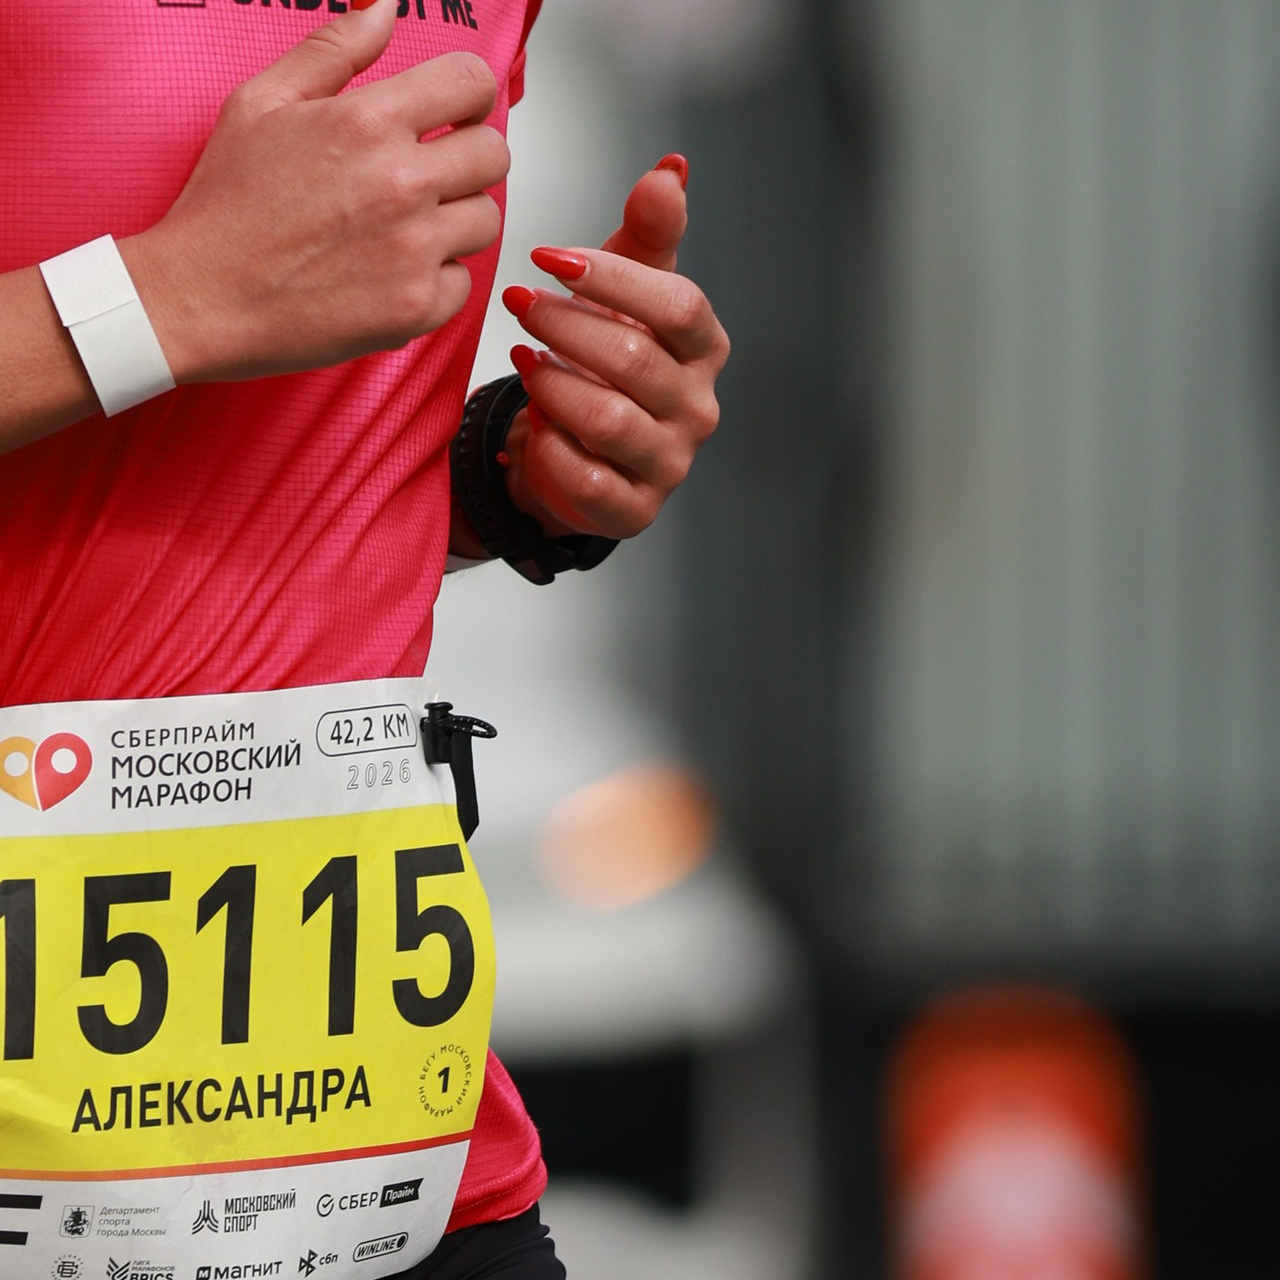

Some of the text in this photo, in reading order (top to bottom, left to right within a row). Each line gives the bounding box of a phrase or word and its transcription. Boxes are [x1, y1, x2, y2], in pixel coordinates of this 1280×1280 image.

[111, 720, 255, 748] СБЕРПРАЙМ
[330, 712, 410, 747] 42,2 КМ
[111, 739, 302, 779] МОСКОВСКИЙ
[346, 758, 411, 790] 2026
[111, 777, 253, 809] МАРАФОН
[437, 1066, 450, 1094] 1
[71, 1065, 372, 1132] АЛЕКСАНДРА
[100, 1206, 160, 1215] Департамент
[224, 1188, 297, 1215] МОСКОВСКИЙ
[339, 1186, 415, 1210] СБЕР Прайм
[97, 1228, 167, 1237] города Москвы
[98, 1219, 131, 1227] спорта
[224, 1214, 259, 1233] СПОРТ
[357, 1238, 397, 1258] WINLINE
